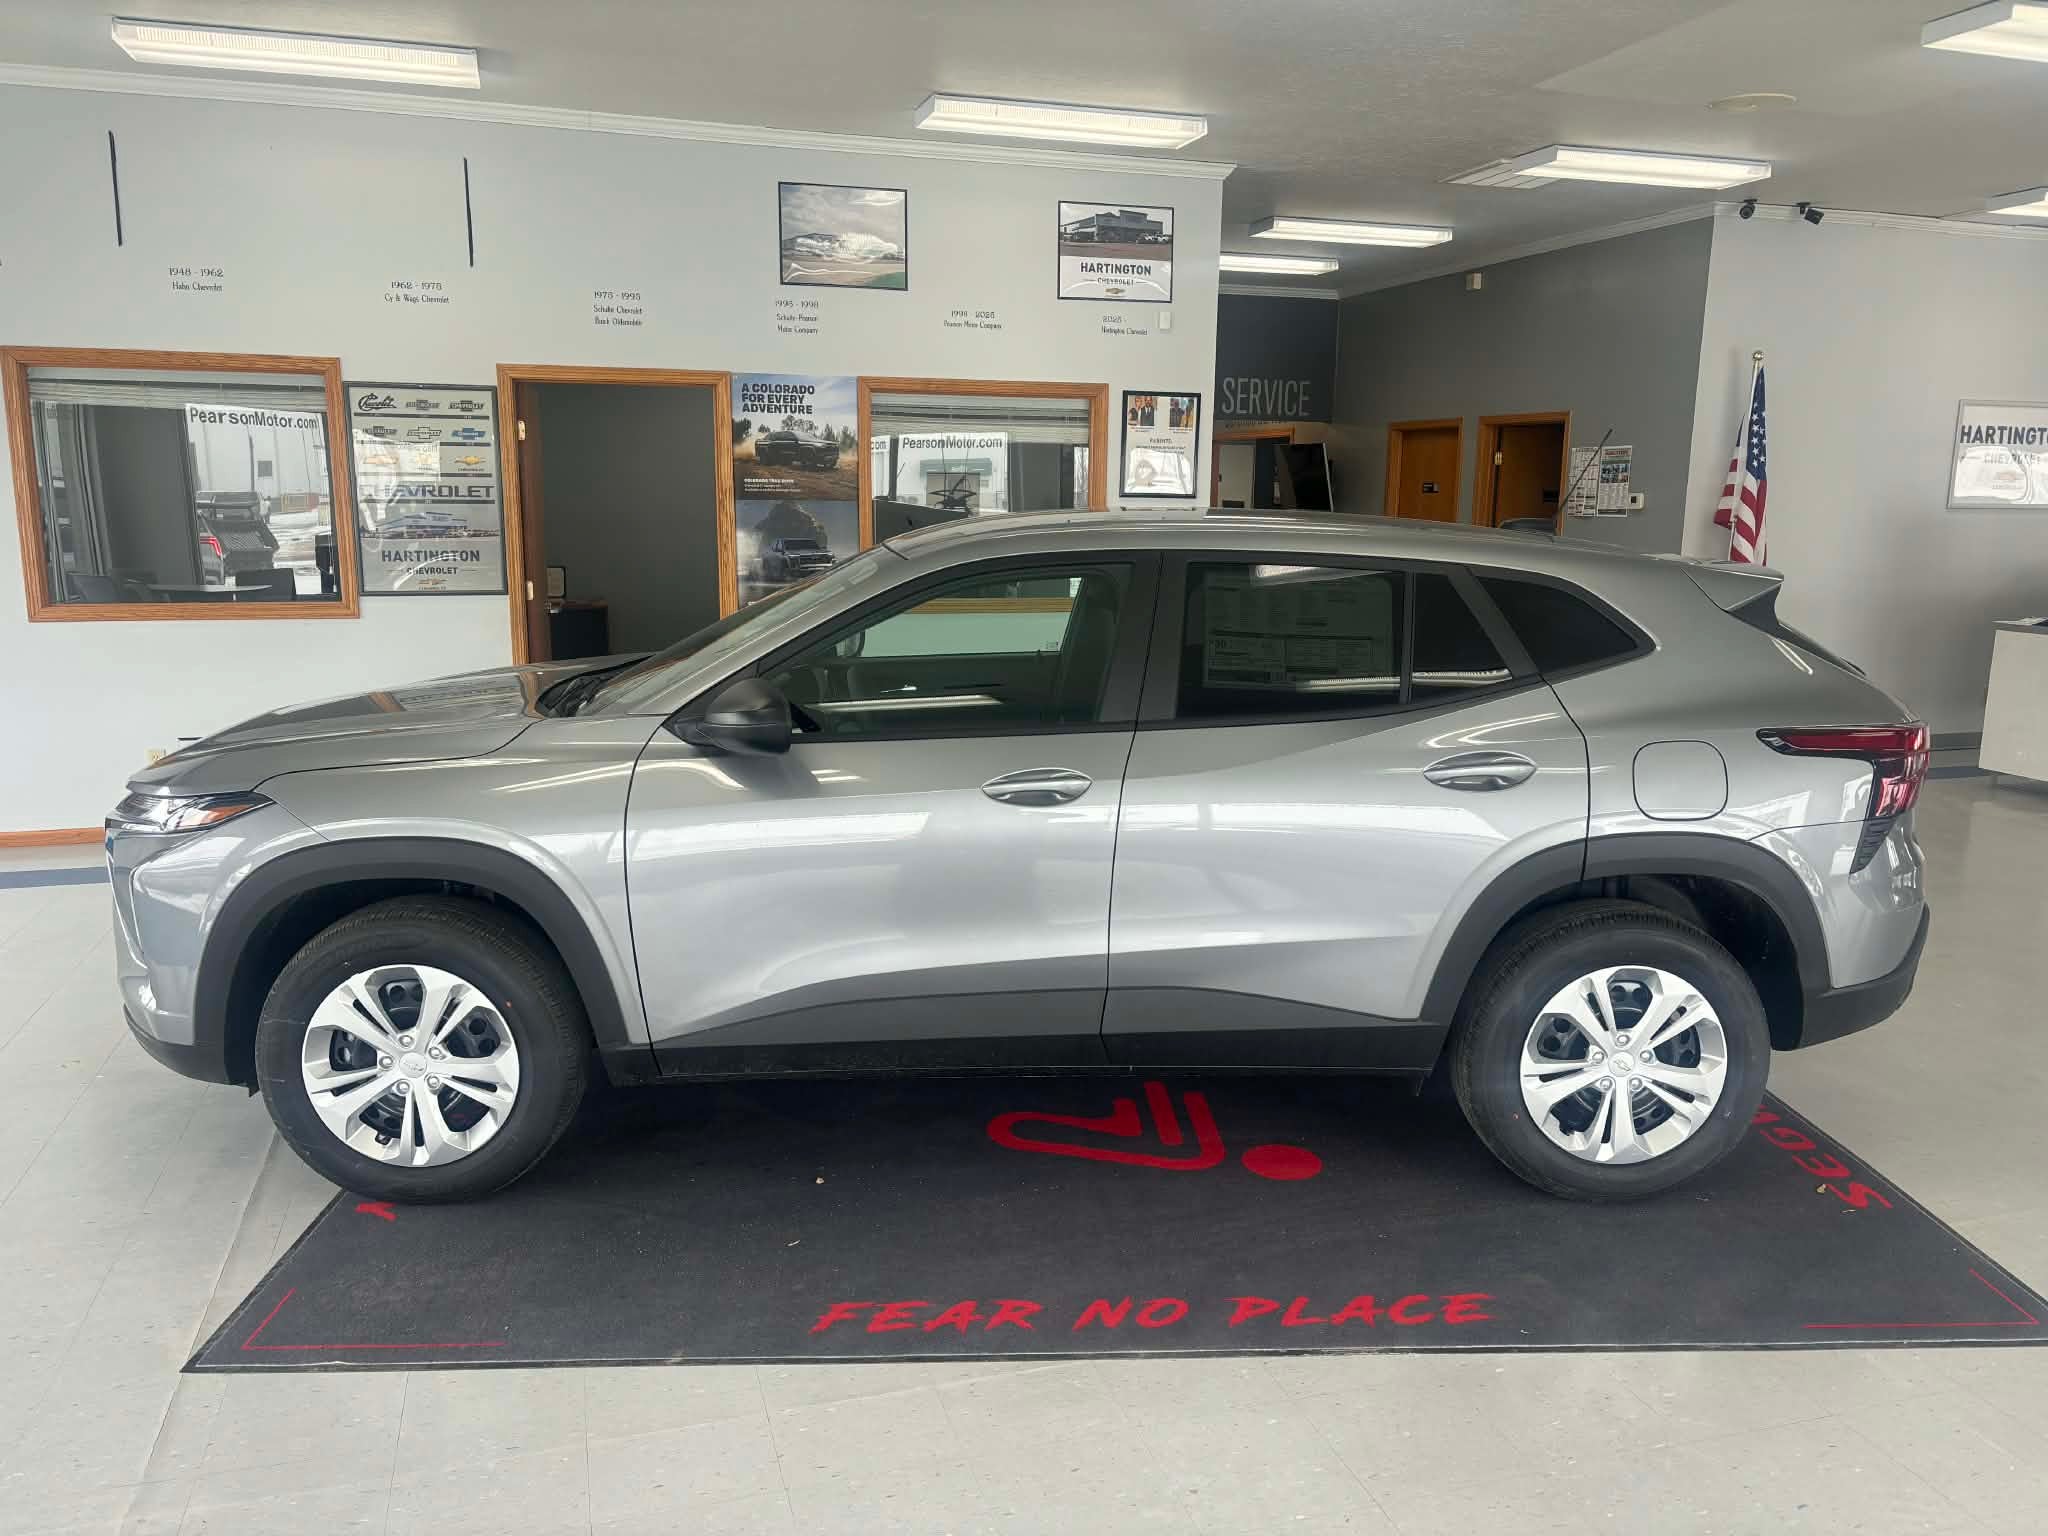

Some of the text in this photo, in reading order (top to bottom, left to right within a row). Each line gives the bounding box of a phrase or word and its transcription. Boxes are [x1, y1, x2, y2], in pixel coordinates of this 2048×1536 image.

[168, 266, 191, 276] 1948
[200, 268, 224, 278] 1962
[1080, 262, 1152, 275] HARTINGTON
[391, 280, 412, 290] 1962
[741, 383, 815, 395] A COLORADO
[741, 393, 805, 405] FOR EVERY
[1222, 377, 1312, 417] SERVICE
[742, 403, 813, 415] ADVENTURE
[189, 407, 319, 430] PearsonMotor.com
[1959, 424, 2048, 446] HARTINGT
[902, 436, 1003, 449] PearsonMotor.com
[360, 484, 496, 498] EVROLET
[381, 550, 480, 562] HARTINGTON
[406, 566, 458, 575] CHEVROLET
[808, 1293, 1496, 1336] FEAR NO PLACE
